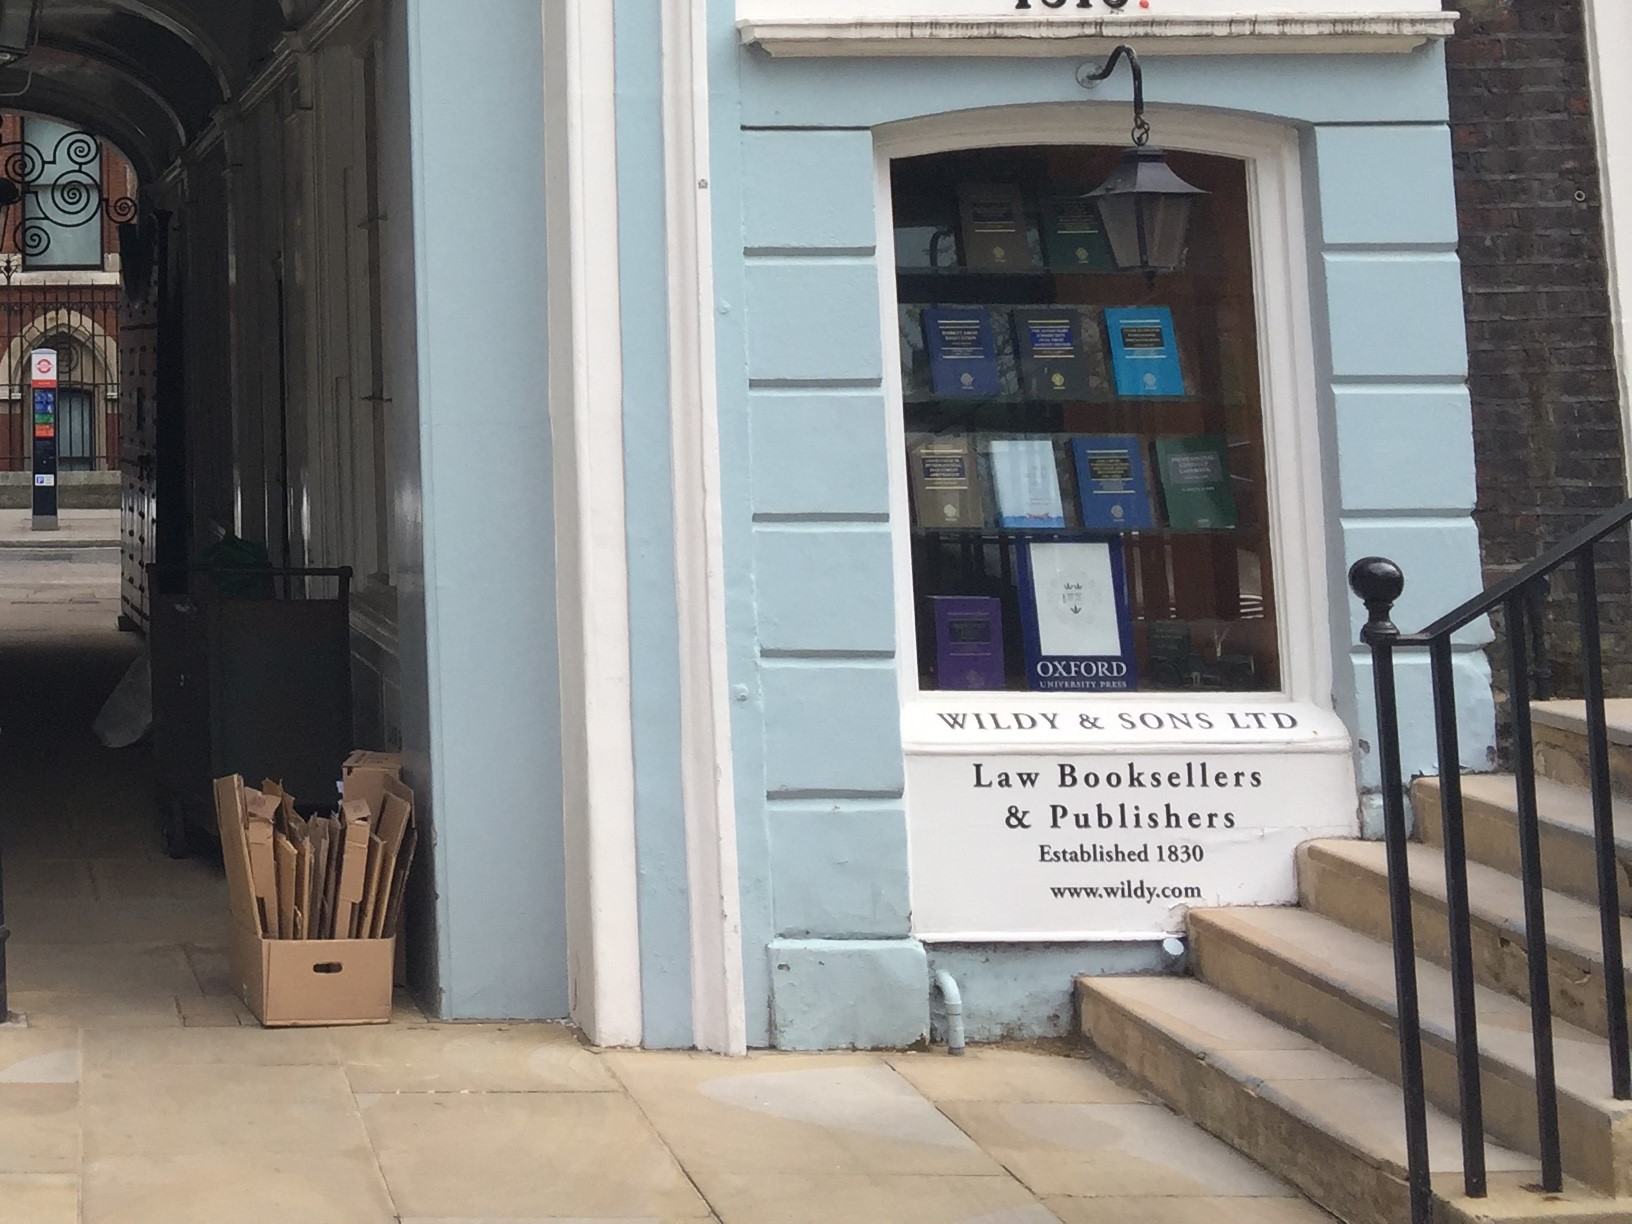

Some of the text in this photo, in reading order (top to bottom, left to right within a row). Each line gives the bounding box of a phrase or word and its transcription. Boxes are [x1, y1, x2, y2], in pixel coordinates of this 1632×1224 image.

[1037, 661, 1127, 677] OXFORD
[938, 713, 1297, 729] WILDY & SONS LTD
[973, 762, 1261, 788] Law Booksellers
[1005, 803, 1234, 828] & Publishers
[1040, 844, 1203, 863] Established 1830
[1050, 880, 1201, 904] www.wildy.com
